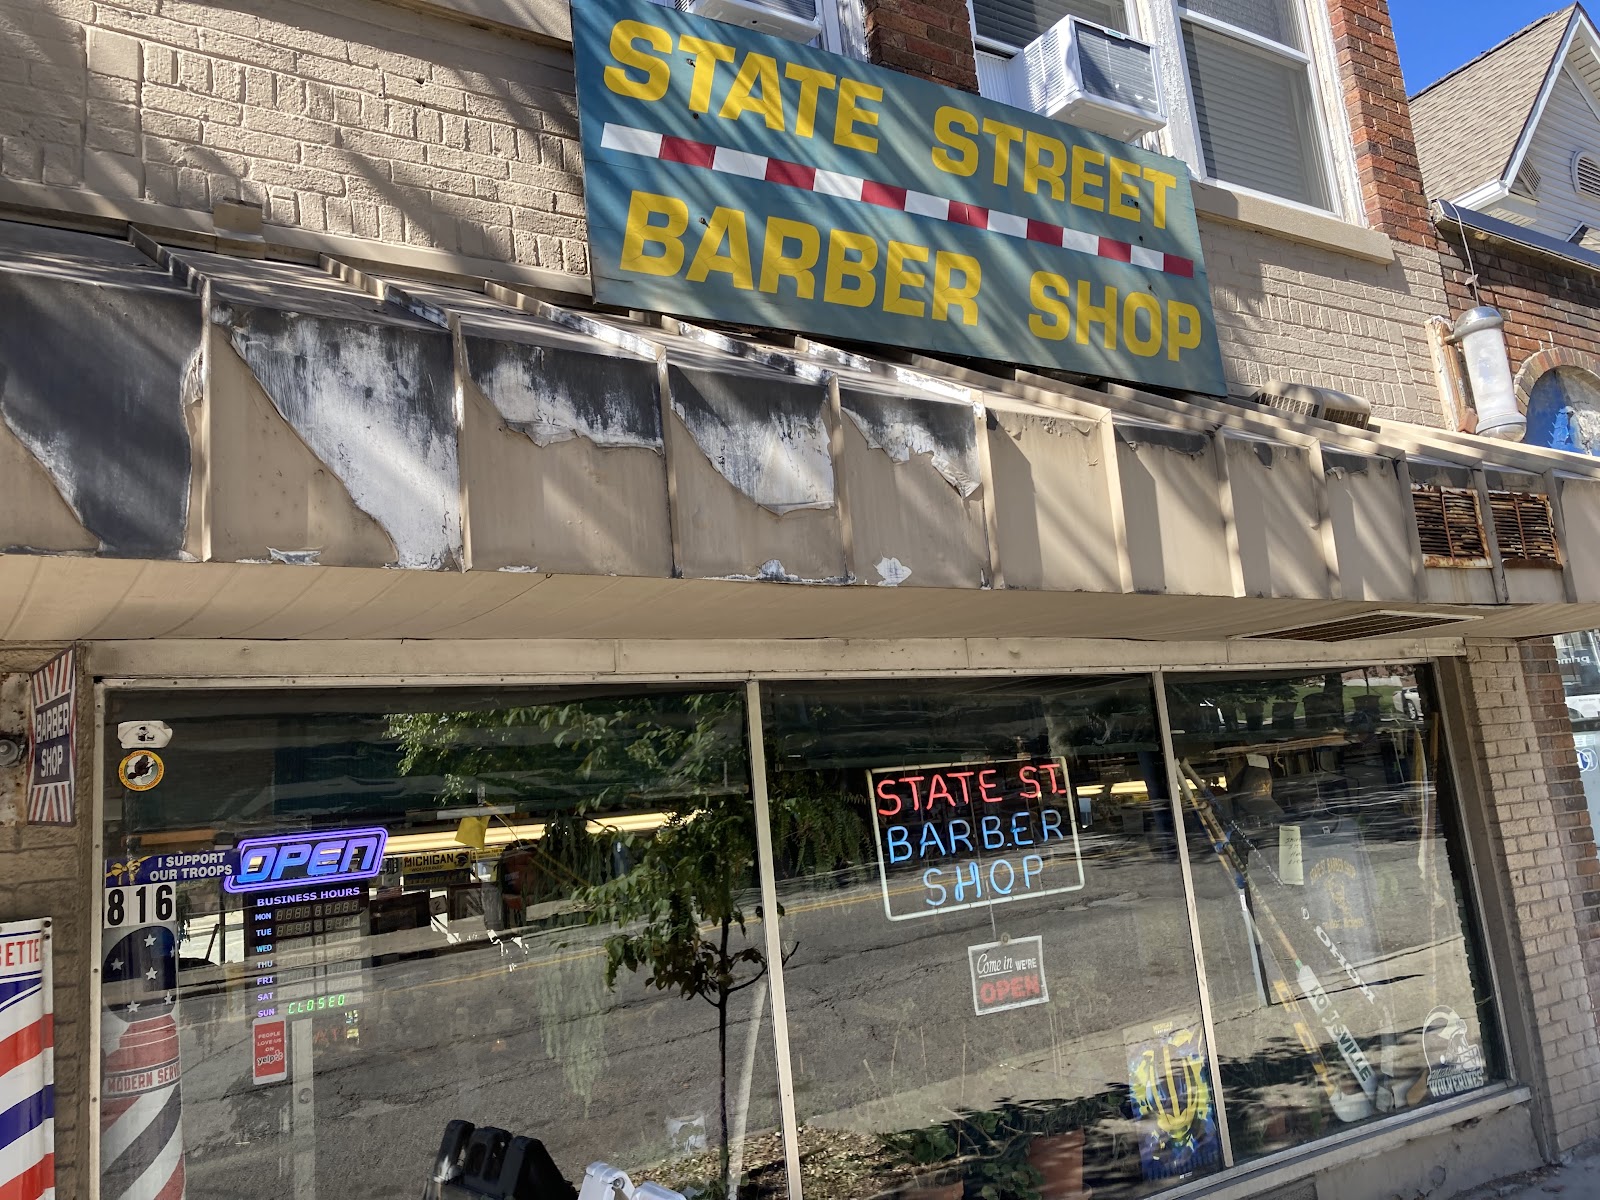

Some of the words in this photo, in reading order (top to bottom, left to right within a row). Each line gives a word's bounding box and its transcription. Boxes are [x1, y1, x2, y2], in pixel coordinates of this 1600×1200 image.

[603, 19, 884, 155] STATE
[931, 105, 1177, 230] STREET
[619, 190, 982, 327] BARBER
[1028, 270, 1202, 362] SHOP
[36, 701, 70, 744] BARBER
[40, 745, 63, 777] SHOP
[877, 769, 1003, 816] STATE
[887, 809, 1064, 864] BARBER
[158, 857, 162, 868] I
[166, 852, 226, 868] SUPPORT
[237, 836, 378, 884] OPEN
[404, 853, 454, 867] MICHIGAN
[149, 868, 178, 882] OUR
[181, 864, 233, 879] TROOPS
[922, 854, 1043, 906] SHOP
[107, 884, 173, 926] 816
[257, 891, 317, 907] BUSINESS
[320, 887, 360, 900] HOURS
[255, 912, 272, 921] MON
[256, 928, 272, 937] TUE
[0, 938, 40, 967] ETTE
[256, 945, 273, 953] WED
[257, 960, 273, 969] THU
[977, 953, 1002, 975] Come
[1003, 956, 1014, 971] in
[1015, 957, 1037, 971] WE'RE
[256, 976, 274, 985] FRI
[979, 974, 1041, 1005] OPEN
[257, 992, 274, 1001] SAT
[288, 994, 345, 1014] CLOSED
[258, 1008, 275, 1018] SUN
[258, 1031, 281, 1039] PEOPLE
[257, 1054, 275, 1067] yelp
[107, 1071, 153, 1093] MODERN
[1428, 1069, 1484, 1098] WOLVERINES
